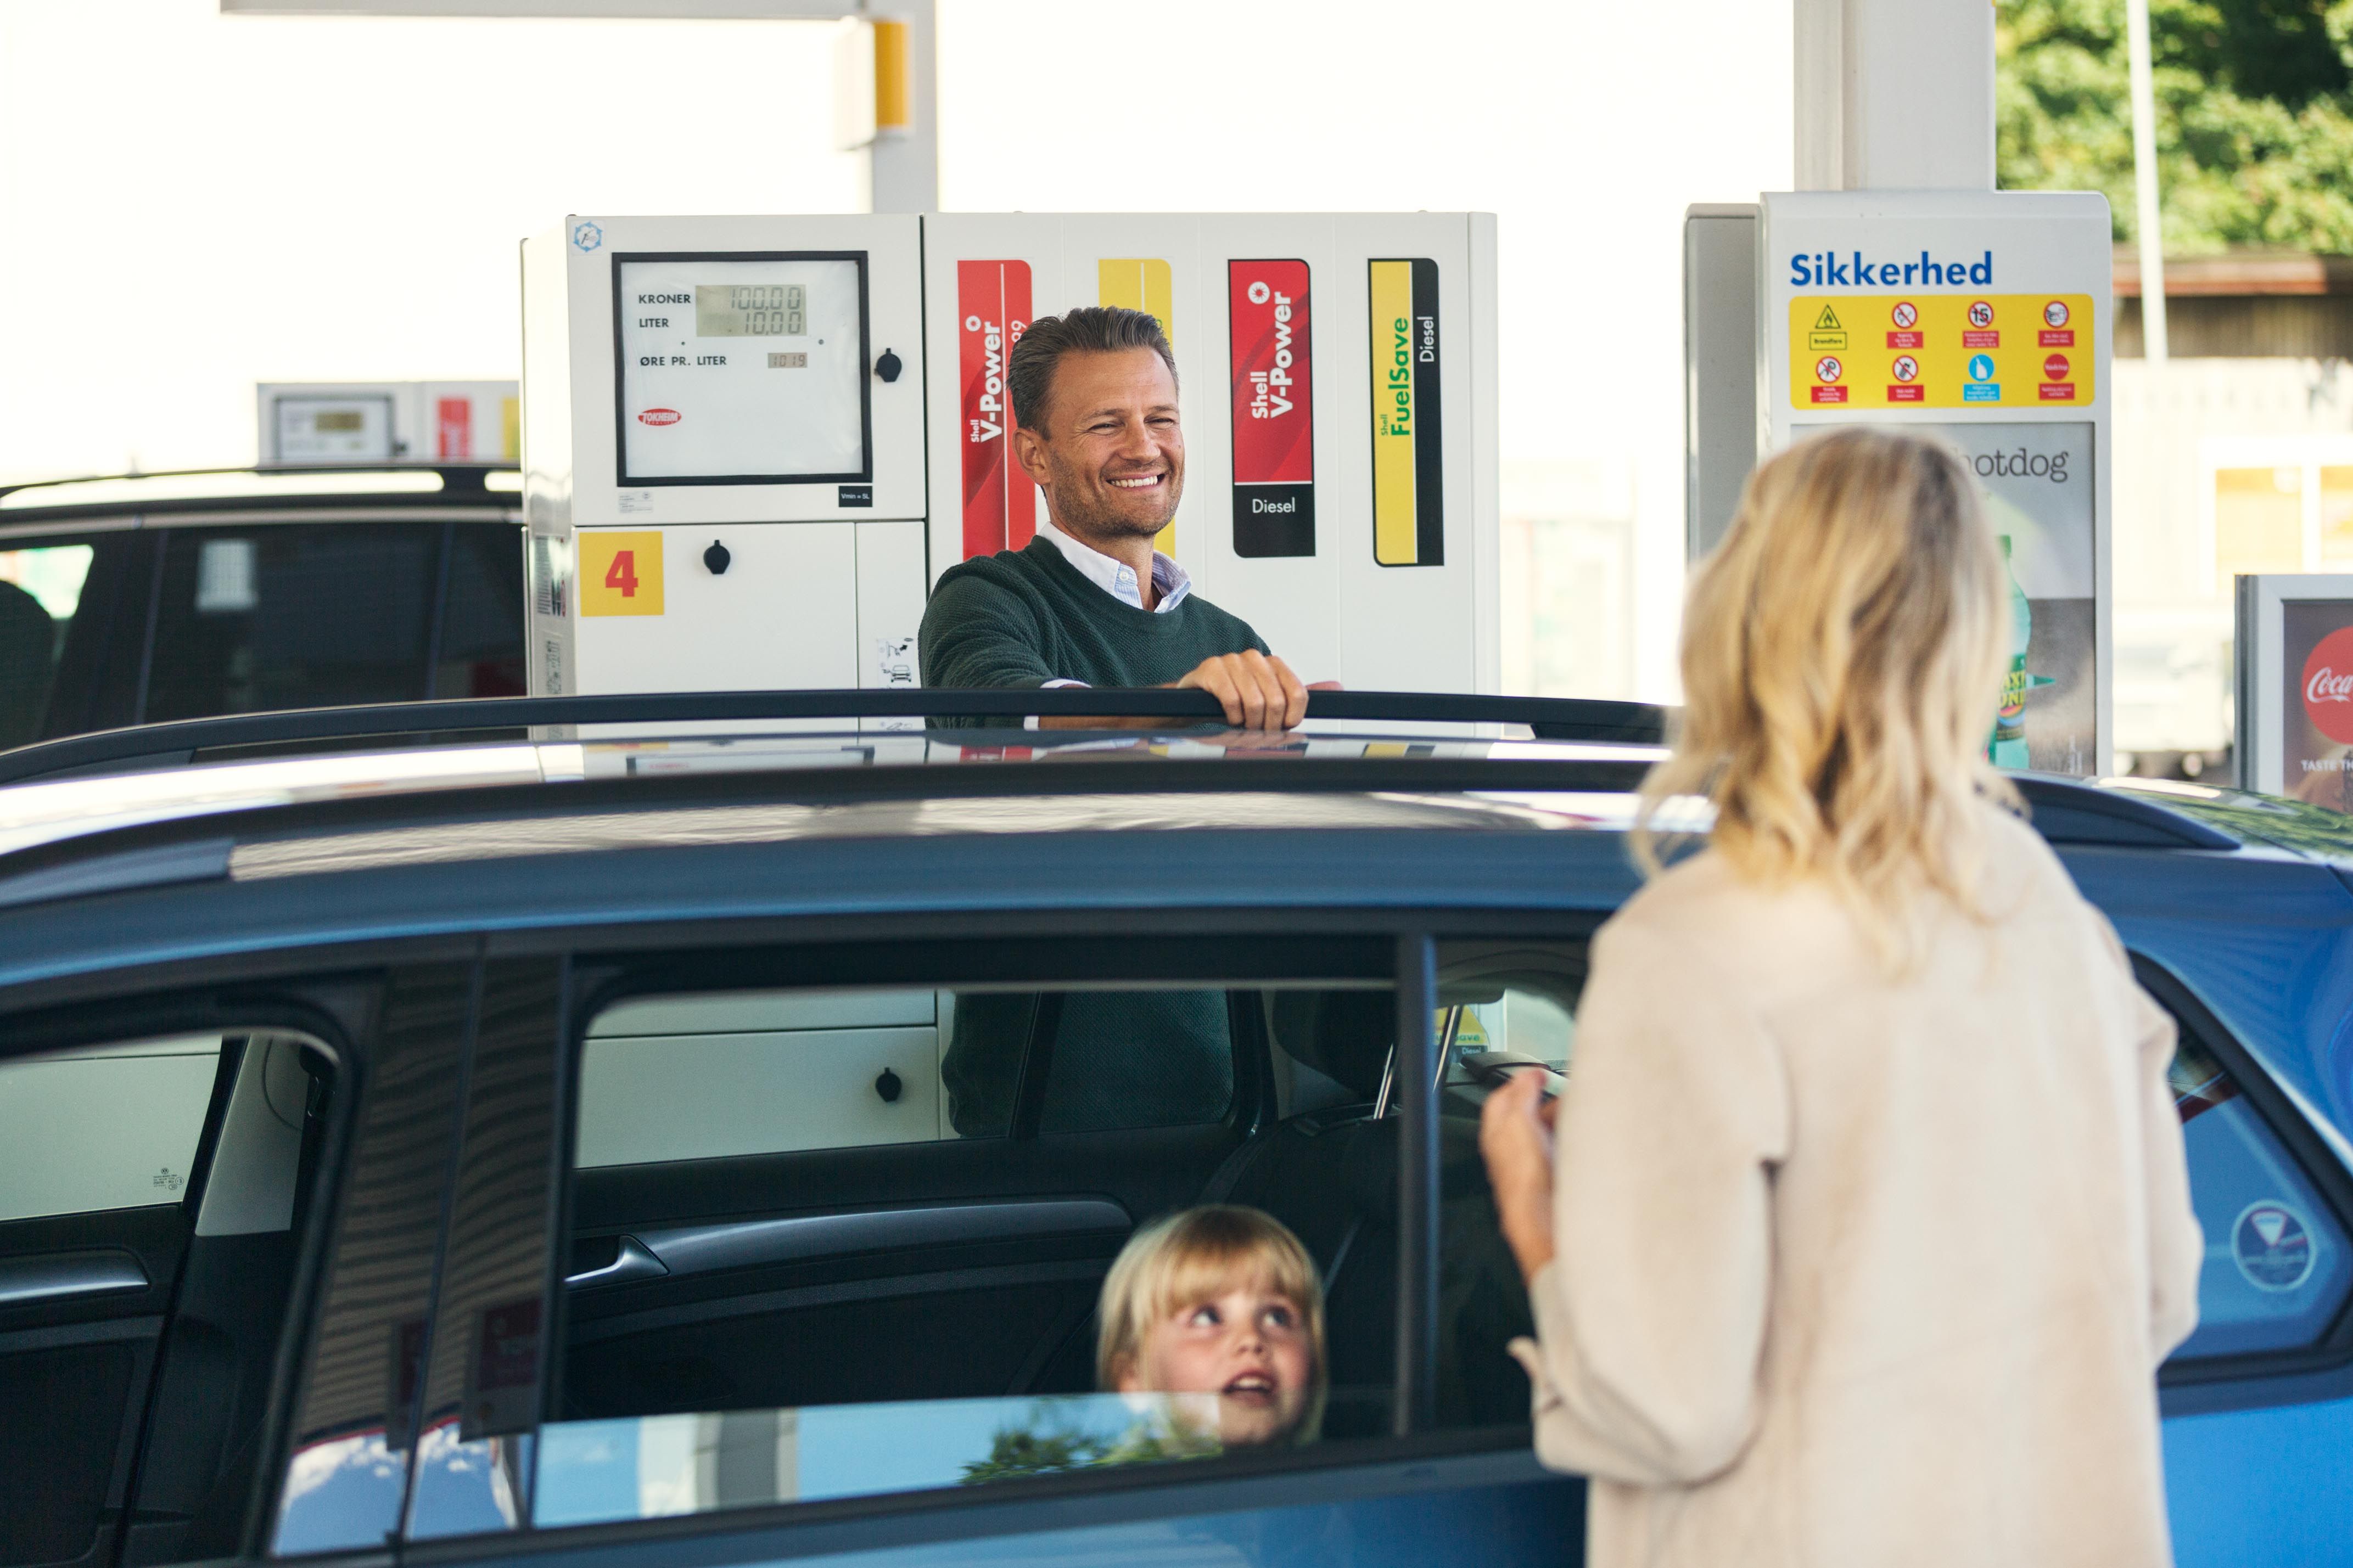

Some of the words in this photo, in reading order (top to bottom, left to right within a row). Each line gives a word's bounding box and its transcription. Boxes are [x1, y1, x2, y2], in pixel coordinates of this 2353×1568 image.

[1790, 251, 1992, 286] Sikkerhed
[638, 294, 691, 304] KRONER
[731, 287, 802, 311] 100,00
[639, 318, 669, 328] LITER
[745, 312, 802, 335] 10,00
[1416, 316, 1435, 363] Diesel
[640, 356, 665, 366] ØRE
[671, 356, 691, 366] PR.
[697, 356, 727, 366] LITER
[1269, 291, 1294, 419] V-Power
[979, 321, 1002, 443] V-Power
[1388, 317, 1411, 437] FuelSave
[1250, 371, 1269, 419] Shell
[970, 419, 980, 443] Shell
[1381, 414, 1389, 436] Shell
[1252, 497, 1296, 514] Diesel
[605, 550, 639, 597] 4
[2301, 759, 2337, 772] TASTE
